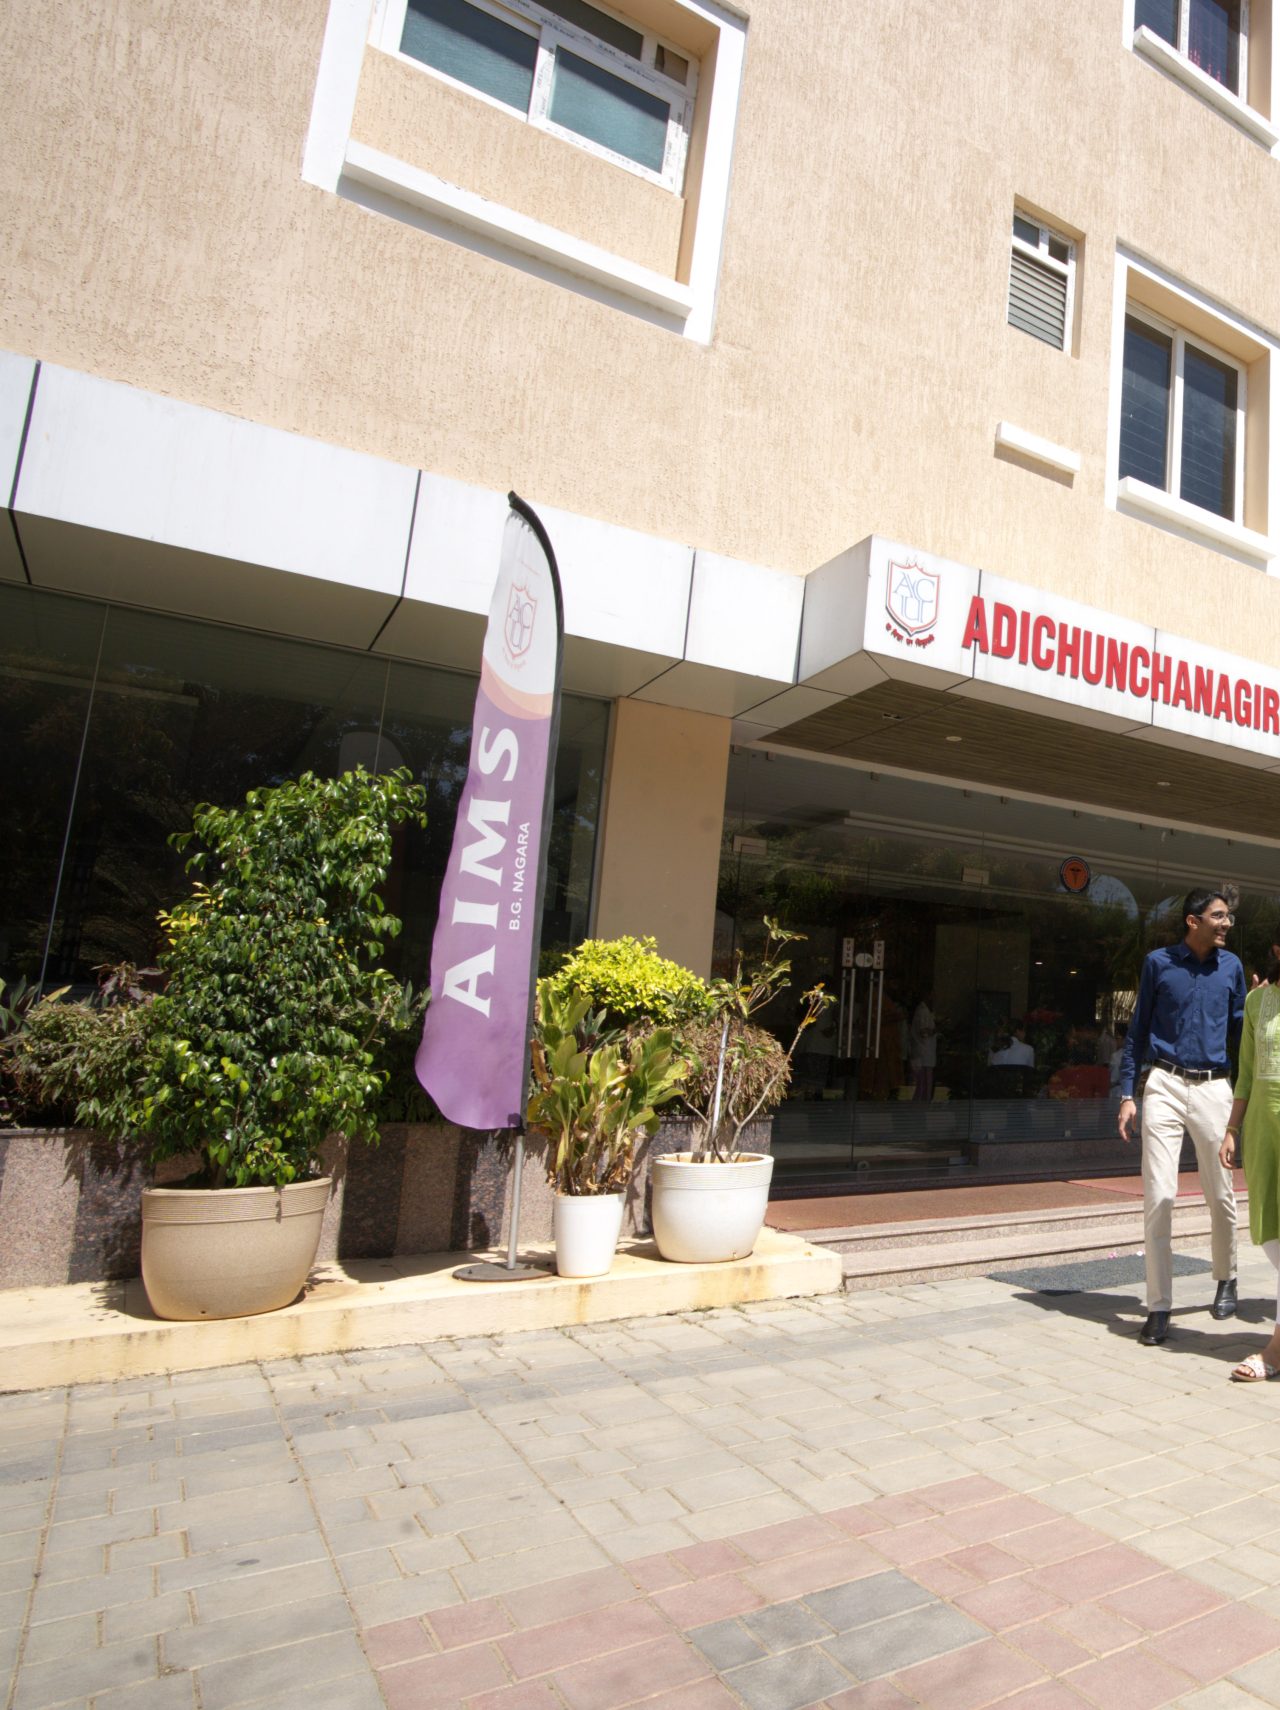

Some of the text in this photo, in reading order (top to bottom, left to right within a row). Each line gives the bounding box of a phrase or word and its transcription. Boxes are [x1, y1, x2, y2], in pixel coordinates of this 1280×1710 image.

[441, 726, 520, 1019] AIMS
[509, 821, 531, 931] B.G. NAGARA
